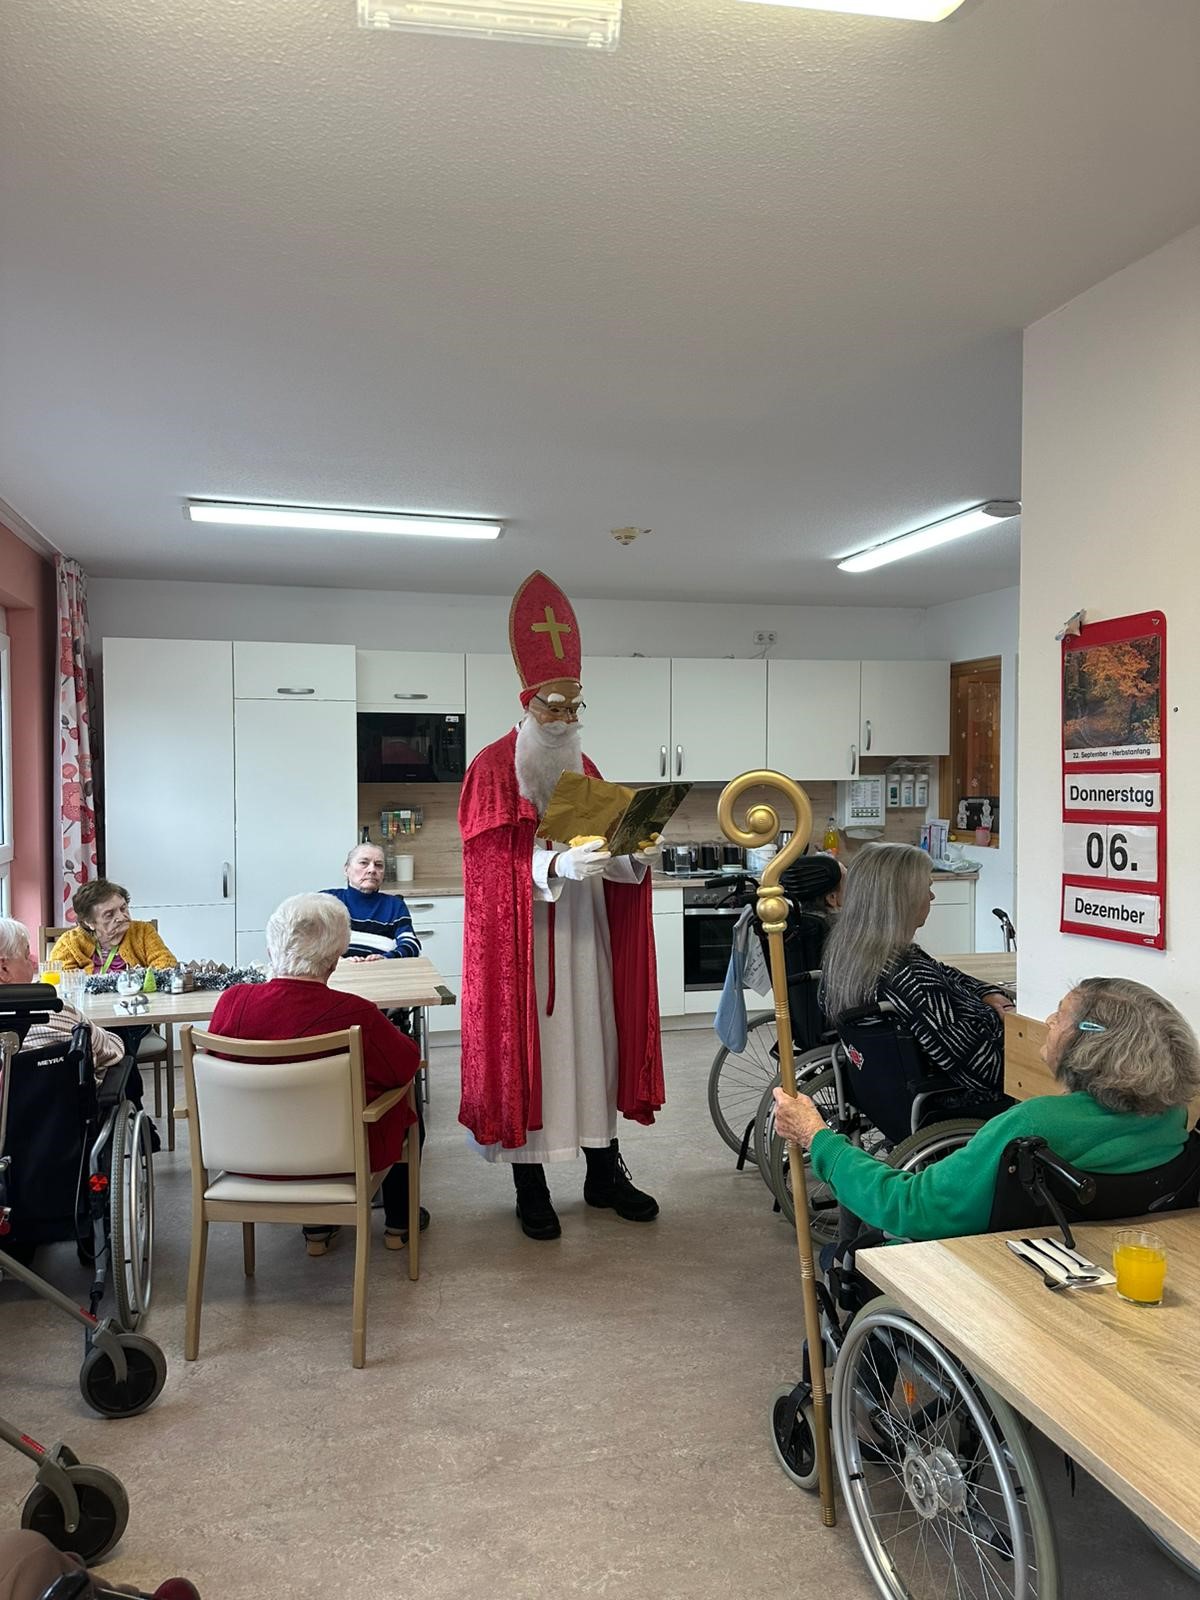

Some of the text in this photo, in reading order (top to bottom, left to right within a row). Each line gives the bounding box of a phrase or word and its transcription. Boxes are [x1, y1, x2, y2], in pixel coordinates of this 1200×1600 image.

[1081, 751, 1108, 759] September
[1112, 748, 1151, 757] Herbstanfang
[1070, 785, 1154, 807] Donnerstag
[1086, 832, 1138, 872] 06.
[1075, 897, 1145, 924] Dezember
[37, 1056, 64, 1066] MEYRA
